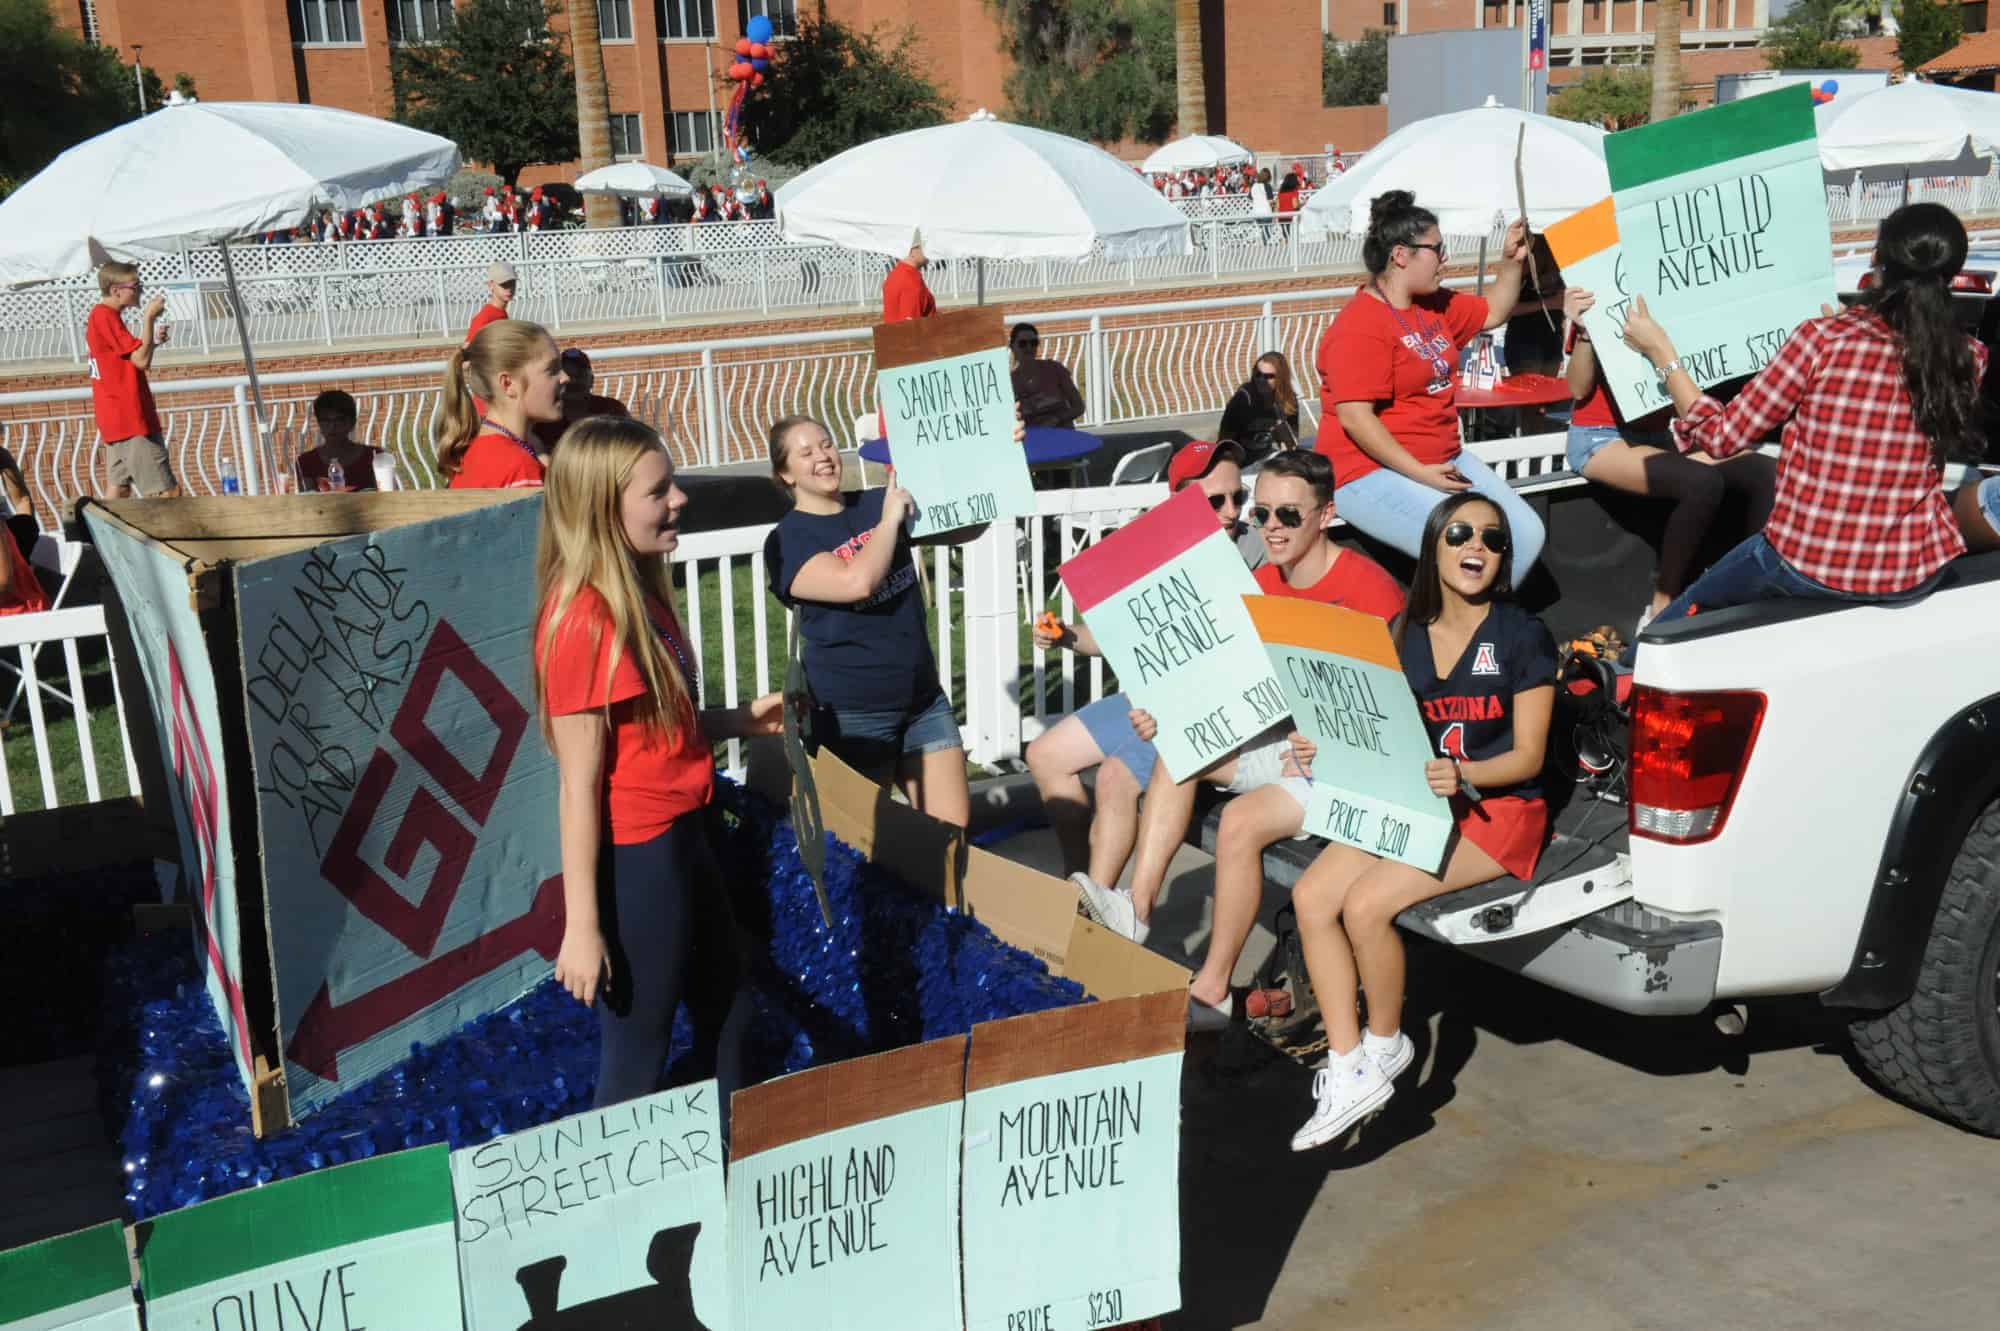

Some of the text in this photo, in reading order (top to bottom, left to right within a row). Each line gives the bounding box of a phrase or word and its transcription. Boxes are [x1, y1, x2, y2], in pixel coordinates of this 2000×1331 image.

[1656, 174, 1772, 254] EUCLID
[1658, 231, 1775, 296] AVENUE
[897, 361, 1002, 421] SANTA RITA
[1680, 344, 1734, 383] PRICE
[916, 408, 989, 447] AVENUE
[928, 492, 998, 530] PRICE $200
[1127, 567, 1202, 637] BEAN
[247, 546, 355, 726] DECLARE
[1133, 600, 1236, 686] AVENUE
[1471, 642, 1501, 675] A
[258, 544, 409, 809] YOUR MAJOR
[1286, 656, 1389, 721] CAMPBELL
[301, 580, 430, 859] AND PASS
[1184, 676, 1290, 759] PRICE $300
[1314, 703, 1391, 757] AVENUE
[1439, 722, 1471, 764] 1
[1326, 798, 1410, 857] PRICE $200
[999, 1080, 1142, 1164] MOUNTAIN
[756, 1144, 896, 1229] HIGHLAND
[1000, 1141, 1125, 1208] AVENUE
[759, 1199, 889, 1282] AVENUE
[1008, 1288, 1122, 1331] PRICE $250
